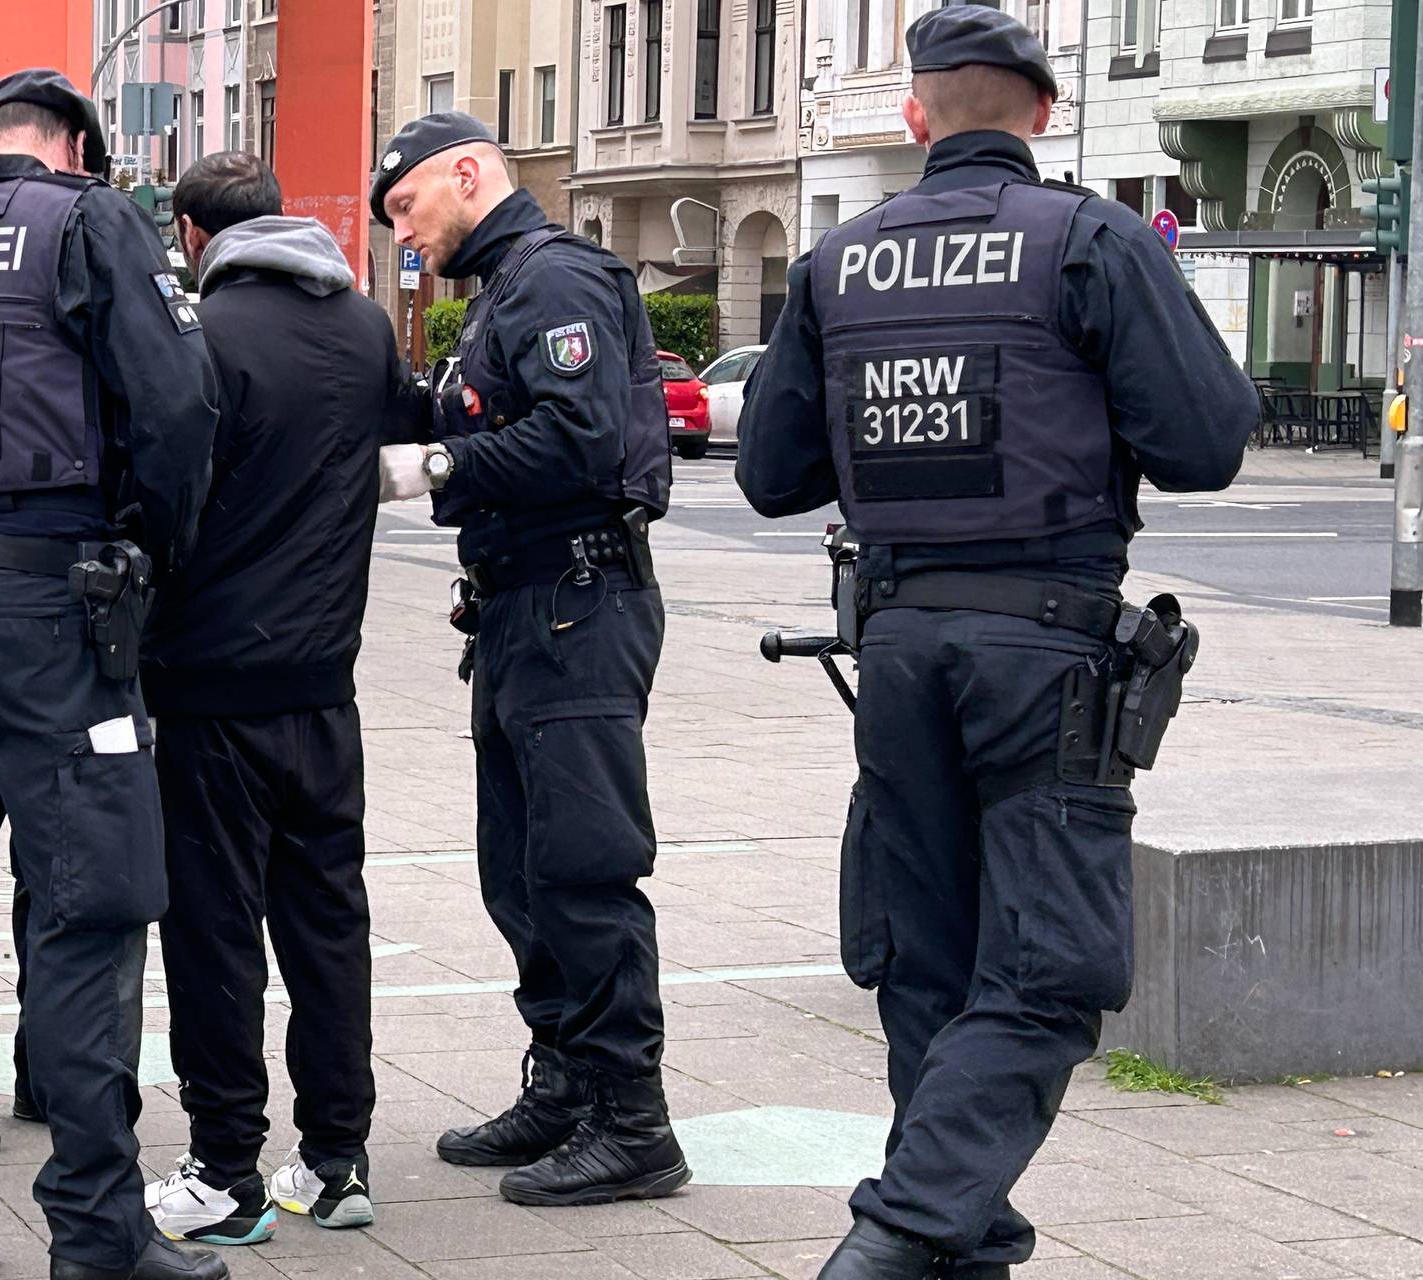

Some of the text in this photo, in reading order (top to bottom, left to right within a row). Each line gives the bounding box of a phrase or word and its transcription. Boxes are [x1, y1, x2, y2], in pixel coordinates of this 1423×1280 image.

[838, 232, 1024, 295] POLIZEI
[865, 356, 965, 399] NRW
[863, 400, 968, 445] 31231
